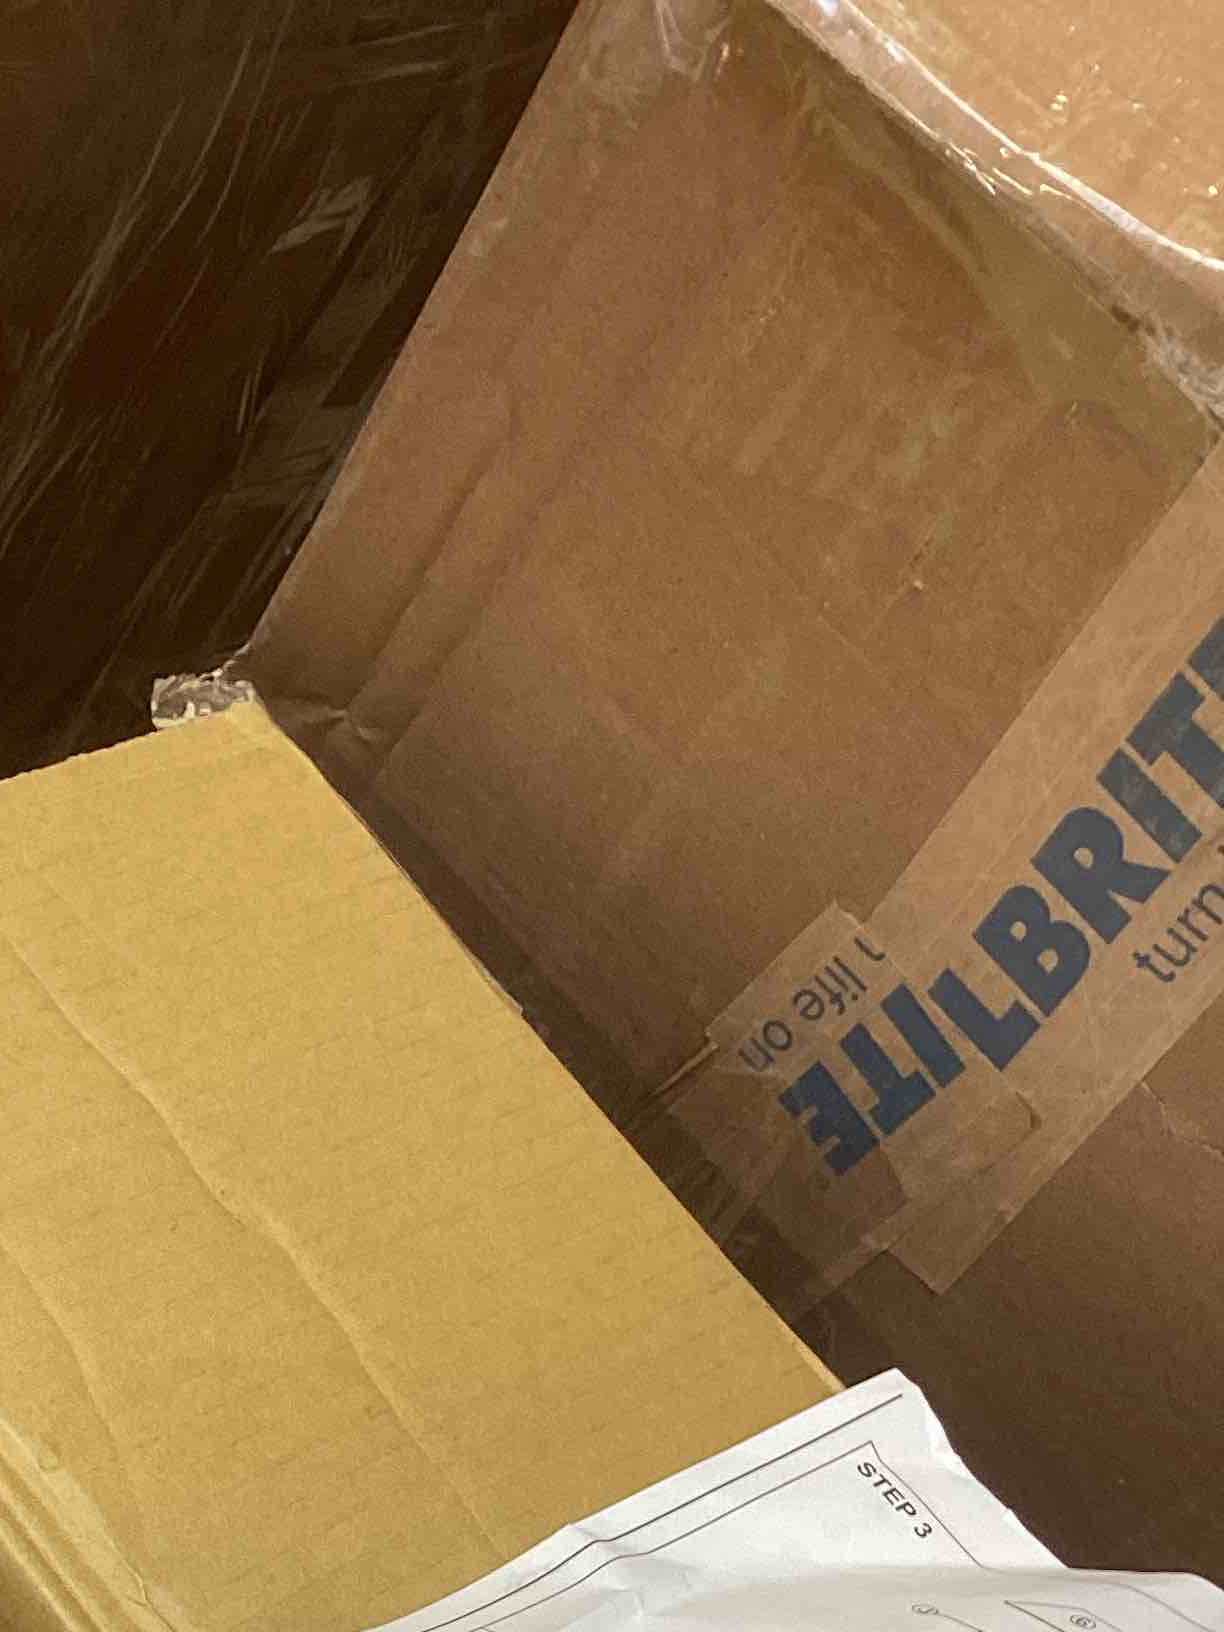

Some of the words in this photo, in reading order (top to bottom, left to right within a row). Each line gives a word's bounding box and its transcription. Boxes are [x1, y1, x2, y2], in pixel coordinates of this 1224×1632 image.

[928, 614, 1224, 1072] LBRIT
[1132, 882, 1224, 982] turn
[793, 956, 868, 1020] life
[737, 1020, 793, 1072] on
[857, 1462, 917, 1516] STEP
[913, 1522, 932, 1538] 3
